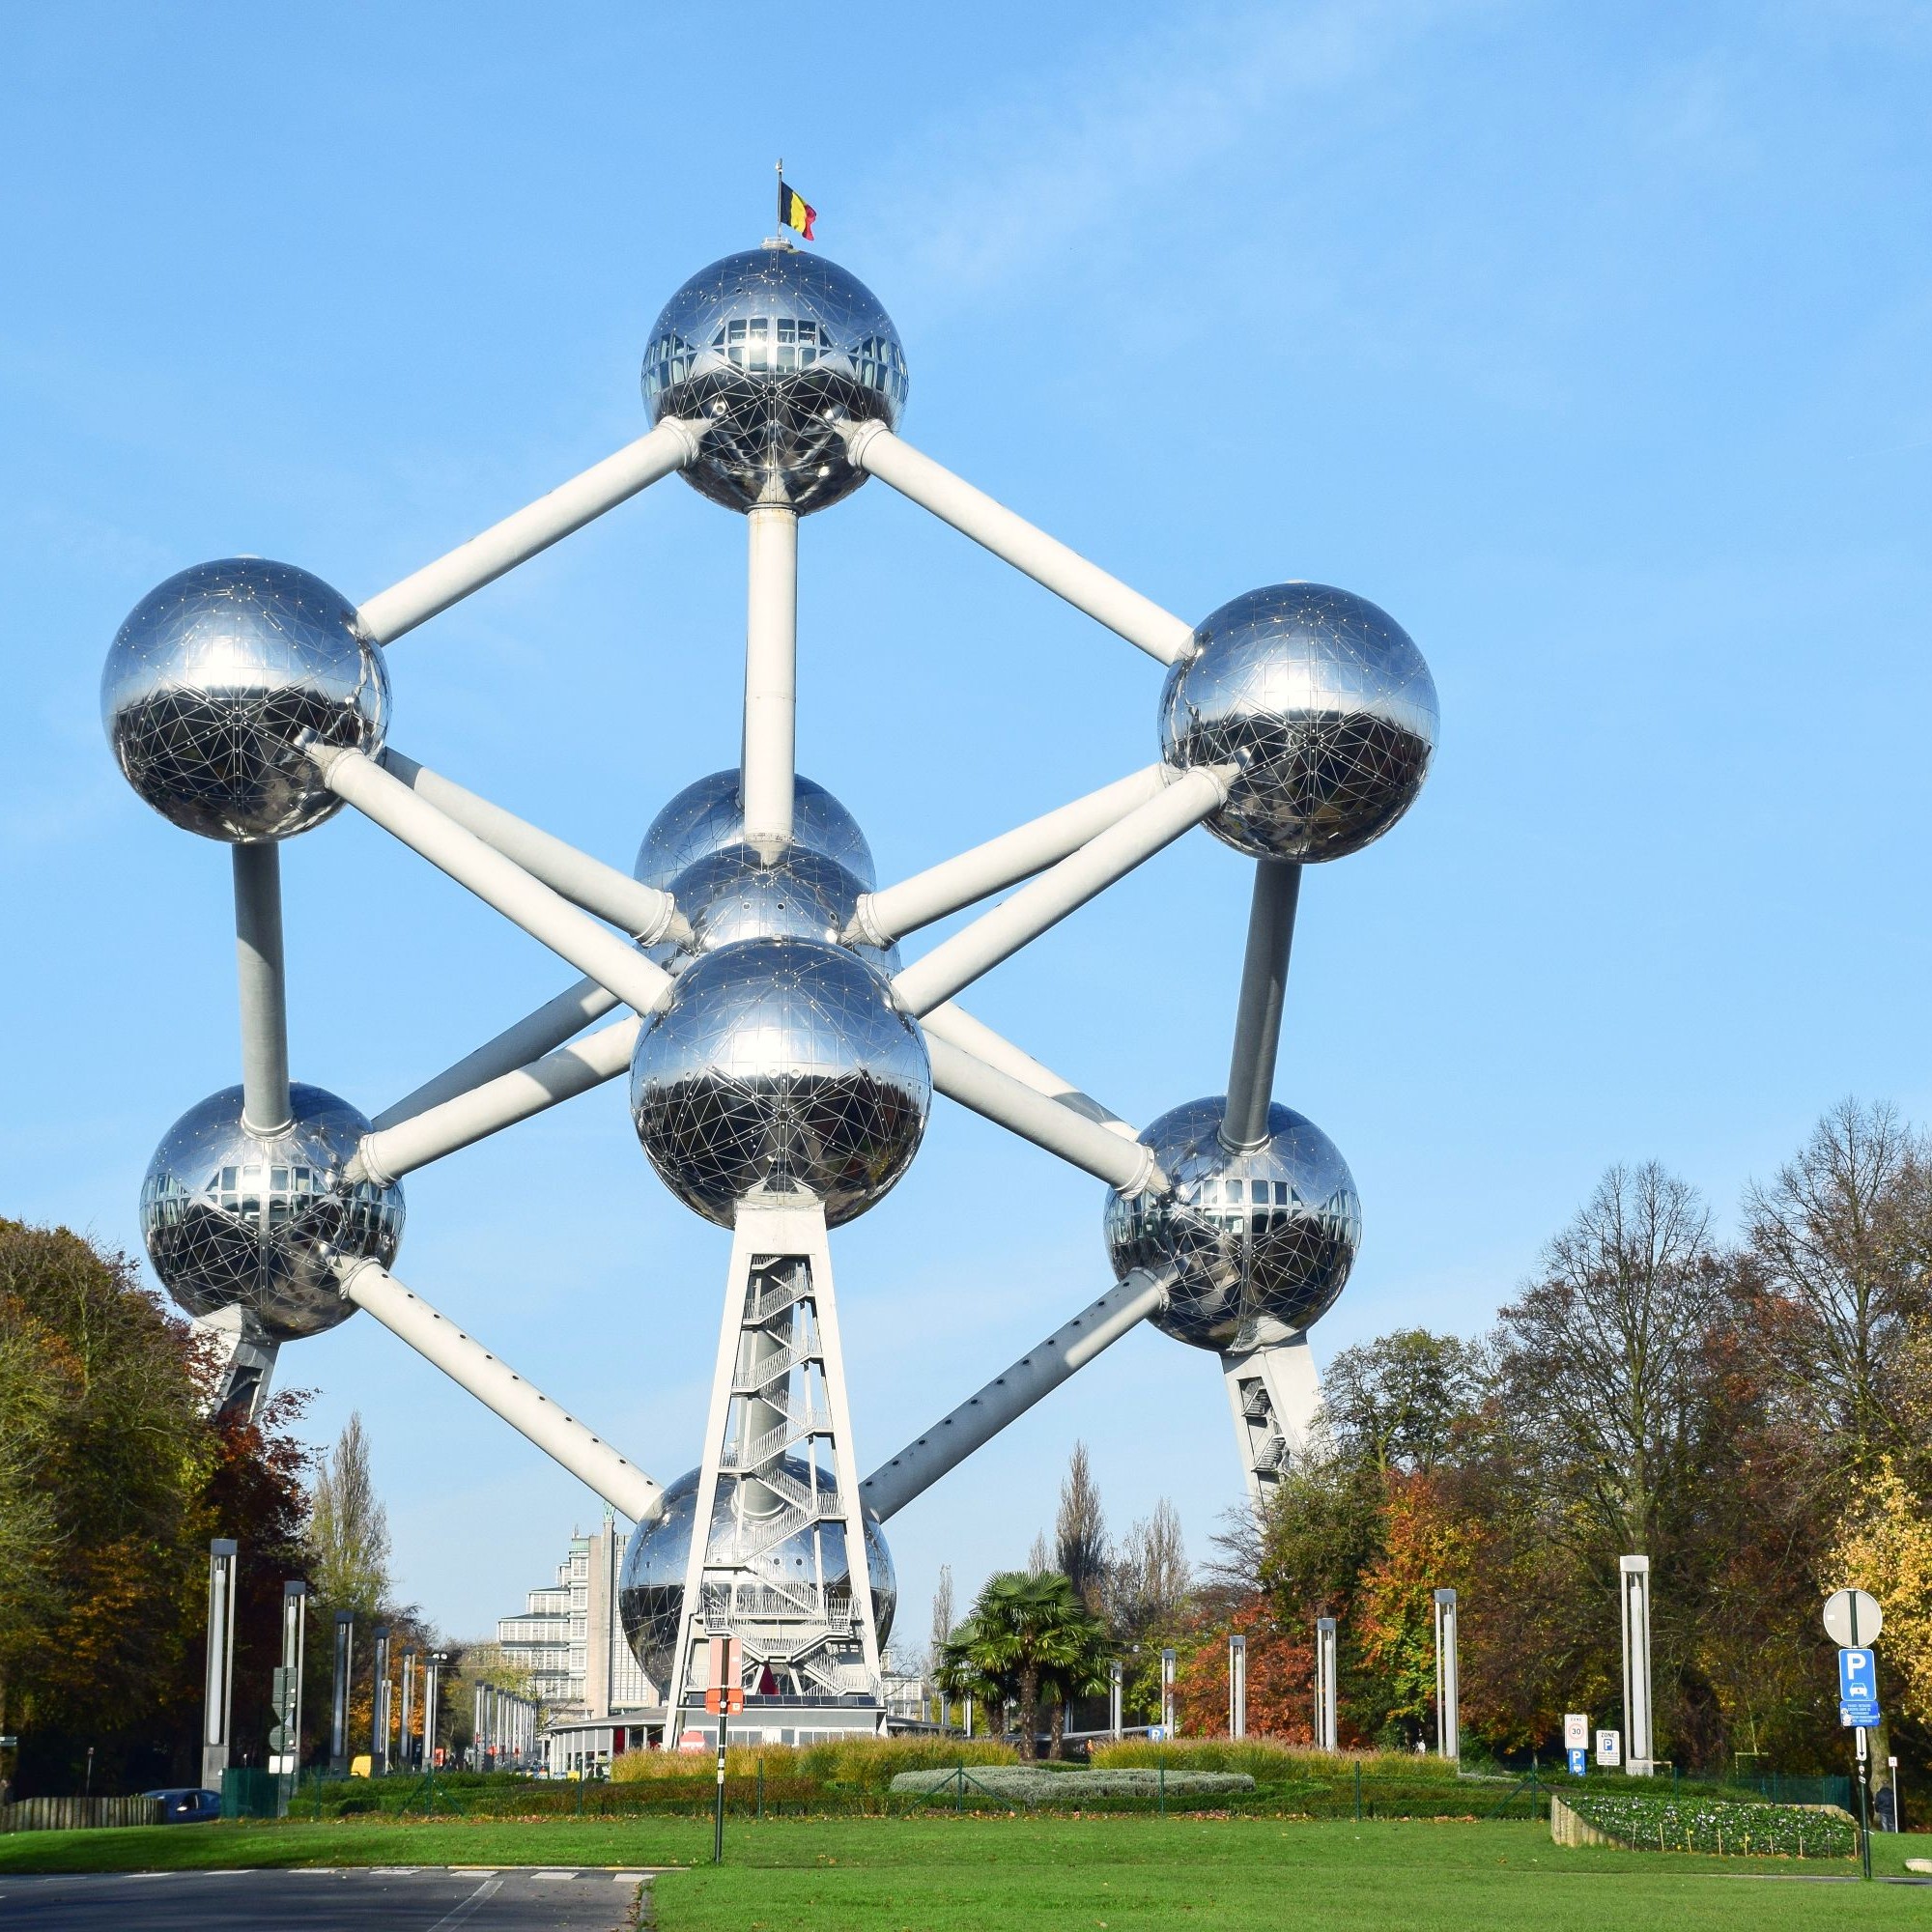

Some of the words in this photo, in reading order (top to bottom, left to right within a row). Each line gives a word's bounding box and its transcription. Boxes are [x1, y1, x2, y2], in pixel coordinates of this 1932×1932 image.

[1847, 1653, 1866, 1680] P
[1605, 1740, 1612, 1750] P
[1572, 1750, 1581, 1763] P
